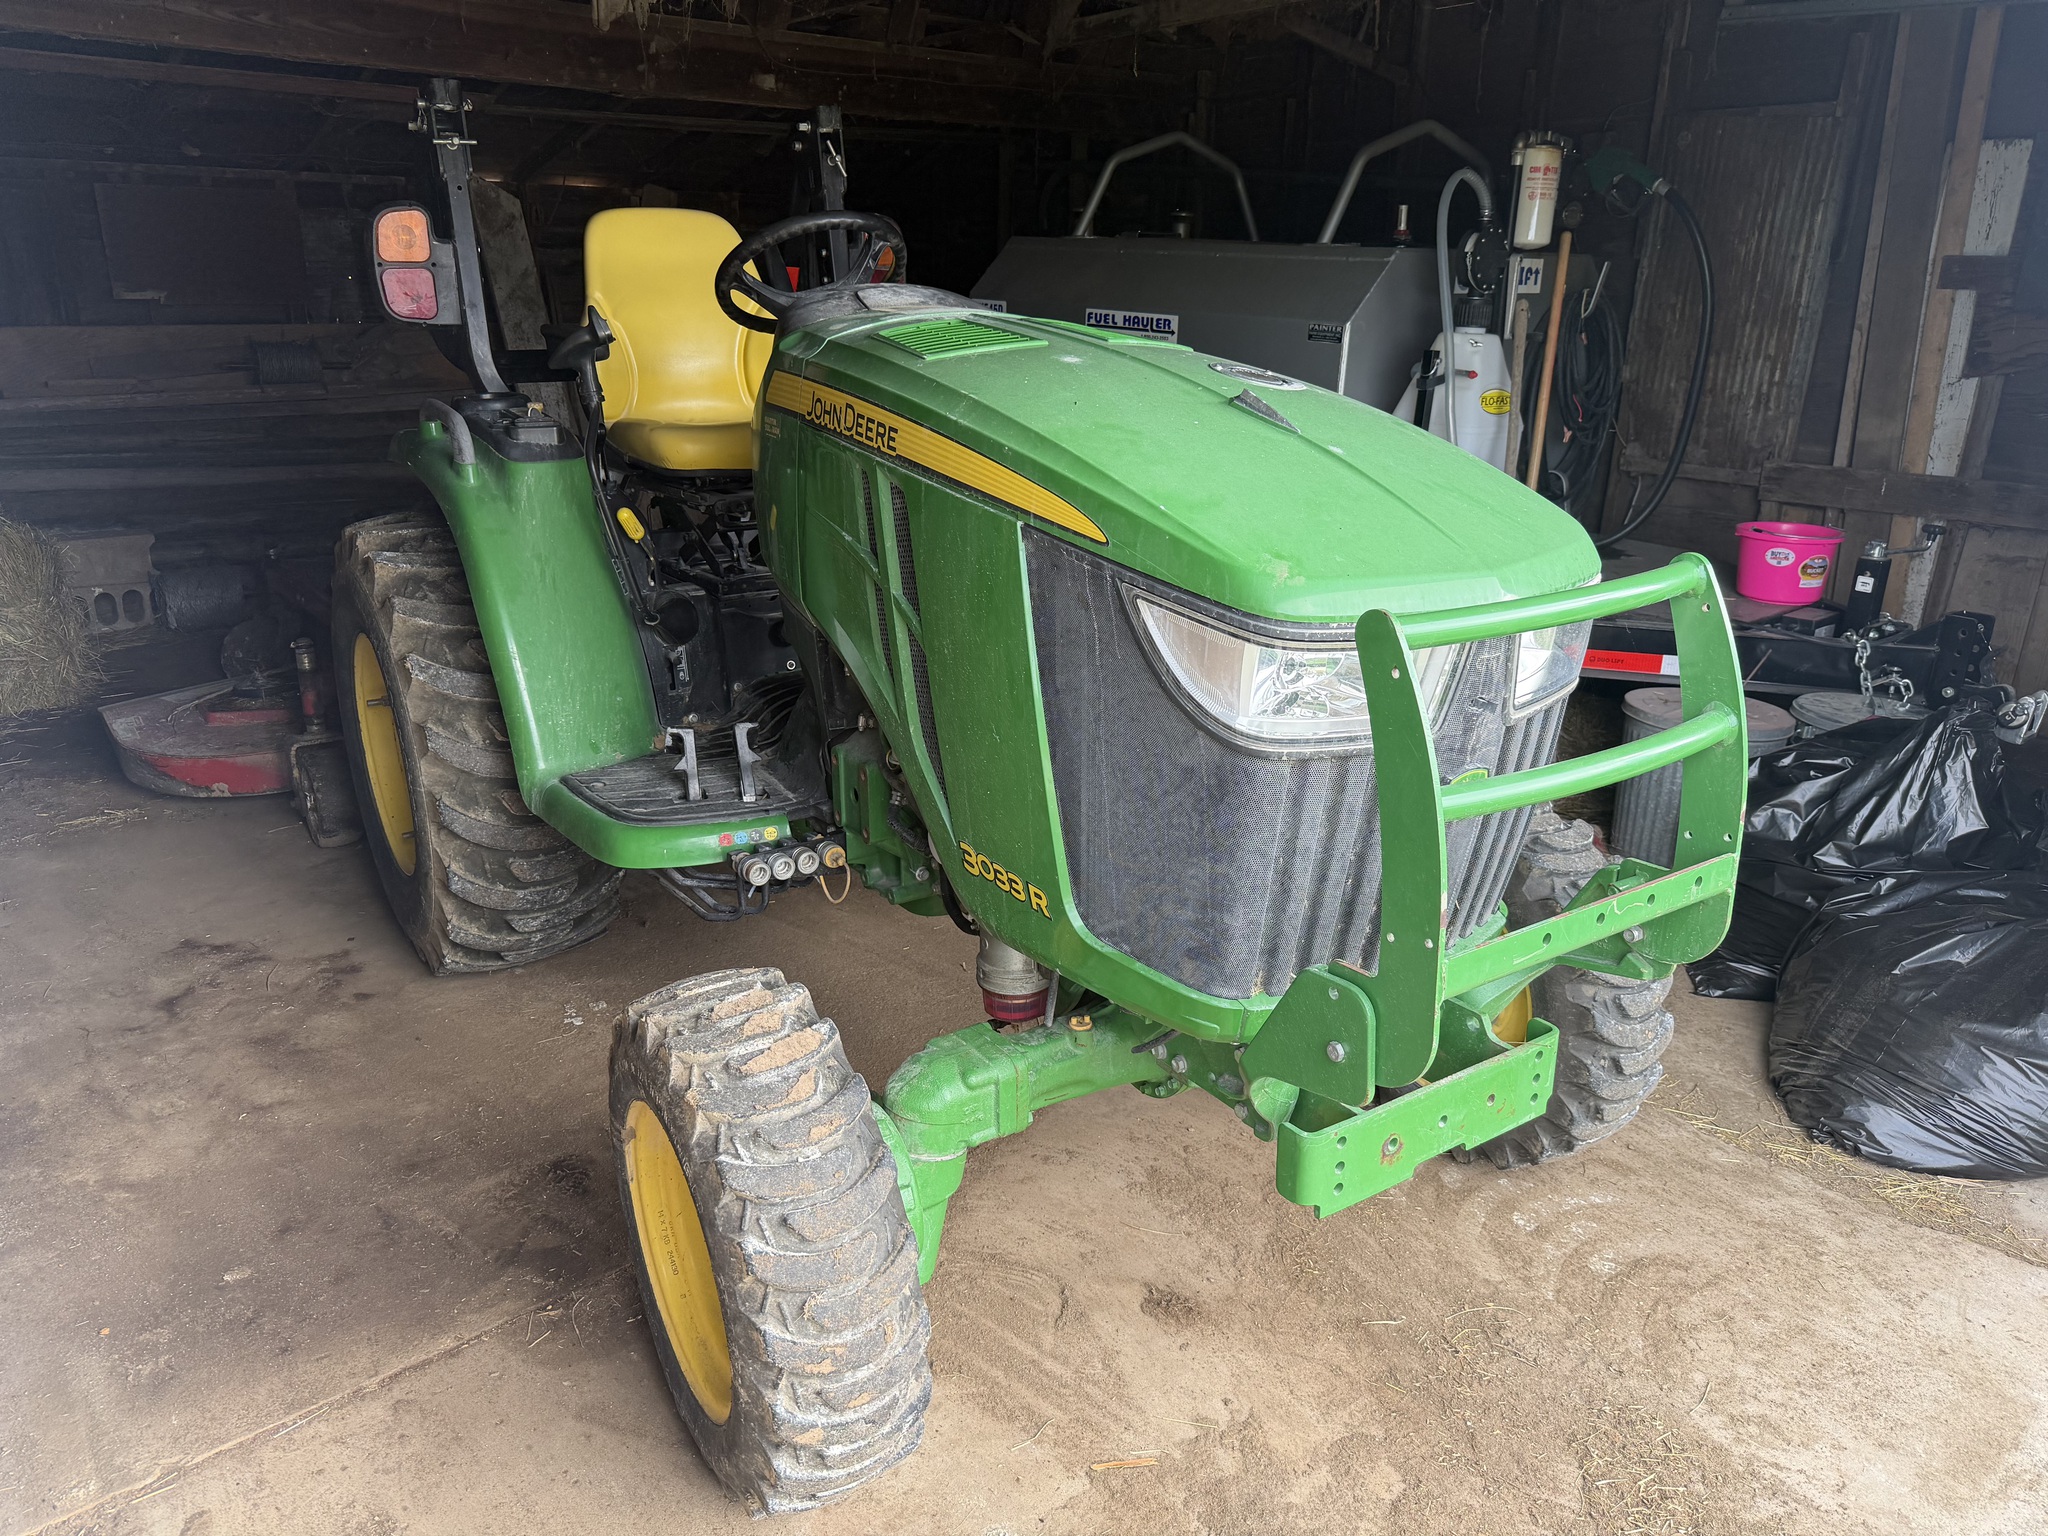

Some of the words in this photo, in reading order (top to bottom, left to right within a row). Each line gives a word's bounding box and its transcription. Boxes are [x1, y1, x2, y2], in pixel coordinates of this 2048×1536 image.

[1087, 312, 1118, 326] FUEL
[1123, 314, 1172, 331] HAULER
[1309, 324, 1342, 332] PAINTER
[806, 391, 842, 430] JOHN
[843, 402, 899, 453] DEERE
[958, 840, 1026, 903] 3033
[1026, 880, 1053, 921] R
